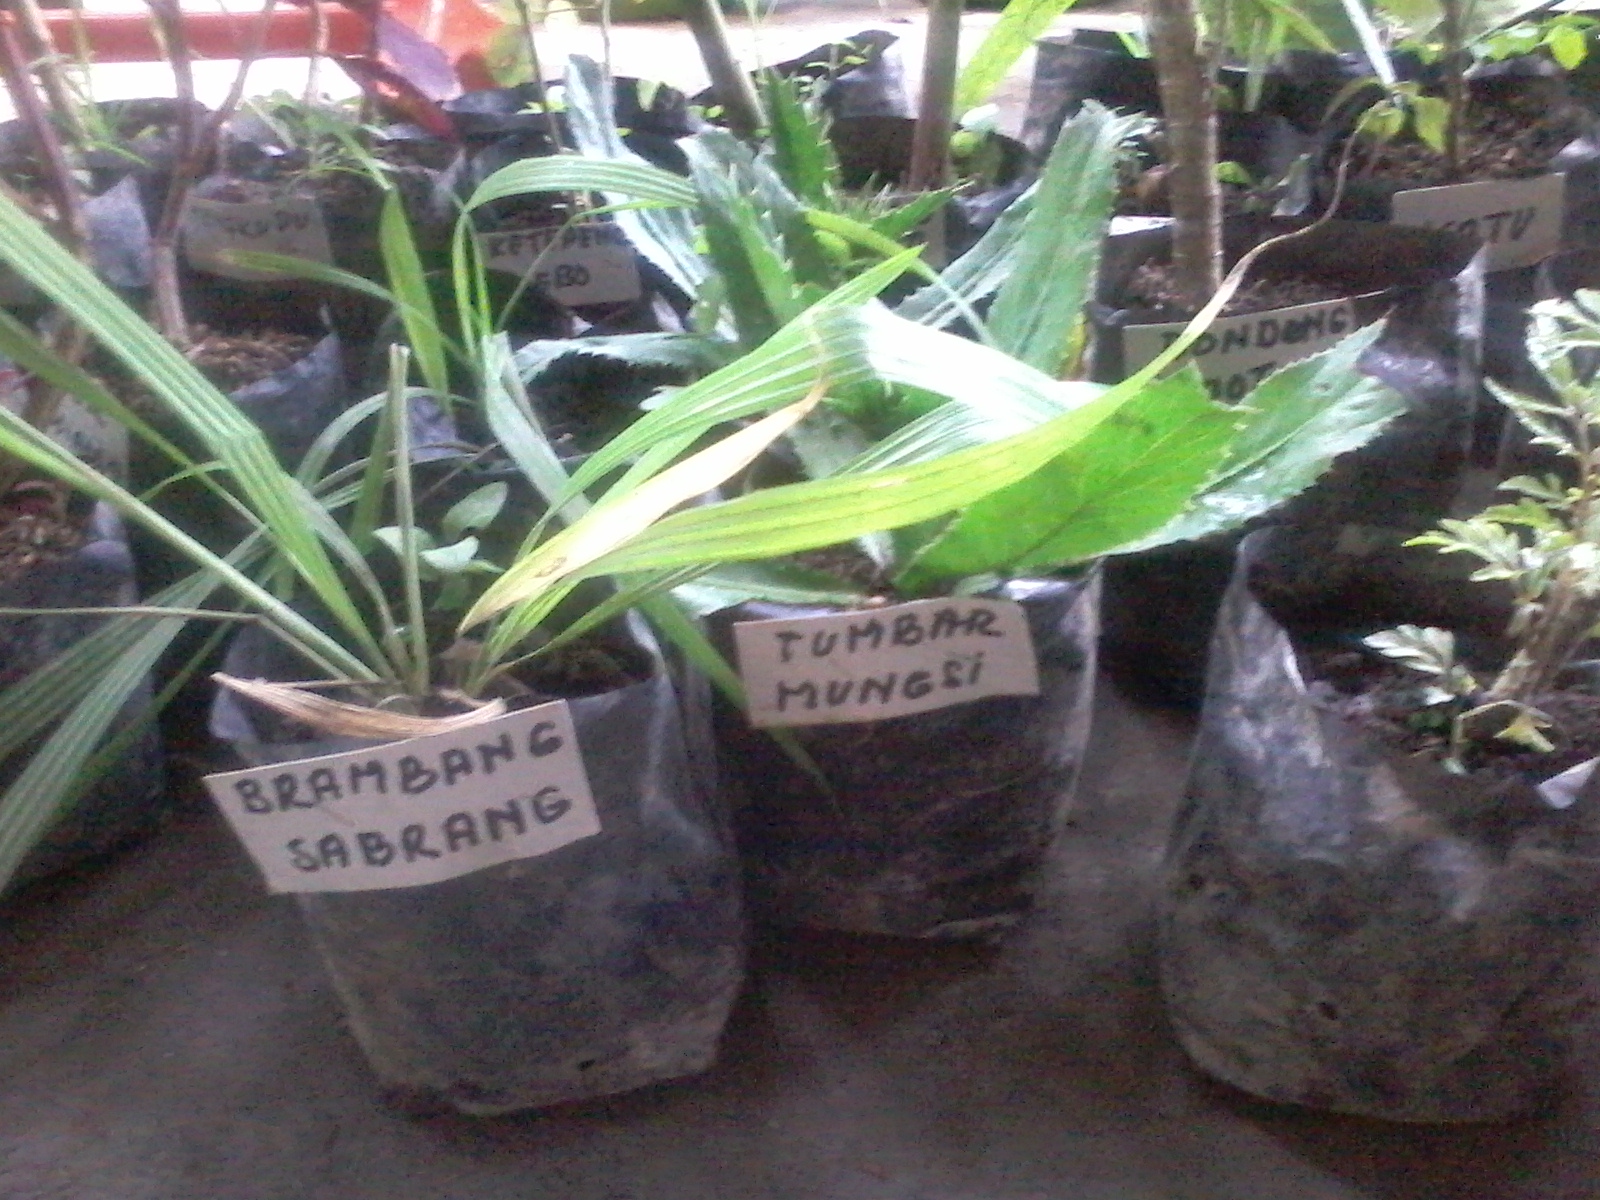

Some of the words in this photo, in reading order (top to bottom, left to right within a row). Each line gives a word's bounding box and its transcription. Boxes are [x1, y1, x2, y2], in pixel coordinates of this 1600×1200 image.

[775, 607, 1005, 663] TUMBAR
[233, 720, 564, 814] BRAMBANG
[285, 785, 573, 872] SABRANG
